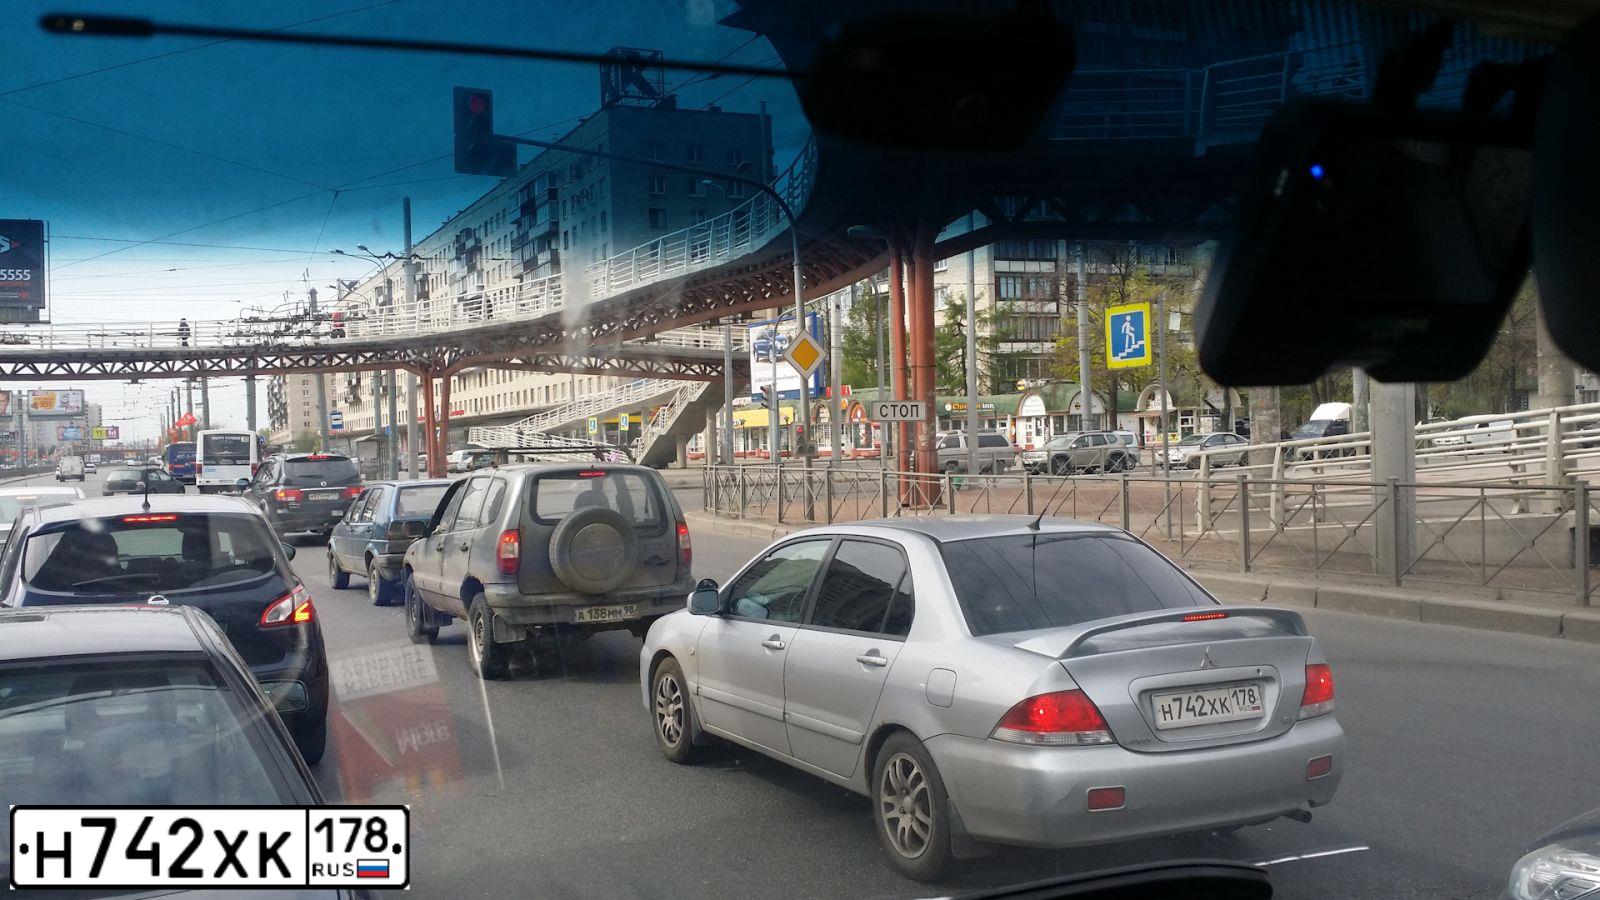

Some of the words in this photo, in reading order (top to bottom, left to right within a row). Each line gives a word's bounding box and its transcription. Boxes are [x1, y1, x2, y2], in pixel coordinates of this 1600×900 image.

[879, 404, 919, 418] СТОП
[624, 605, 634, 614] 98
[1161, 695, 1231, 721] Н742ХК
[1231, 688, 1257, 706] 178
